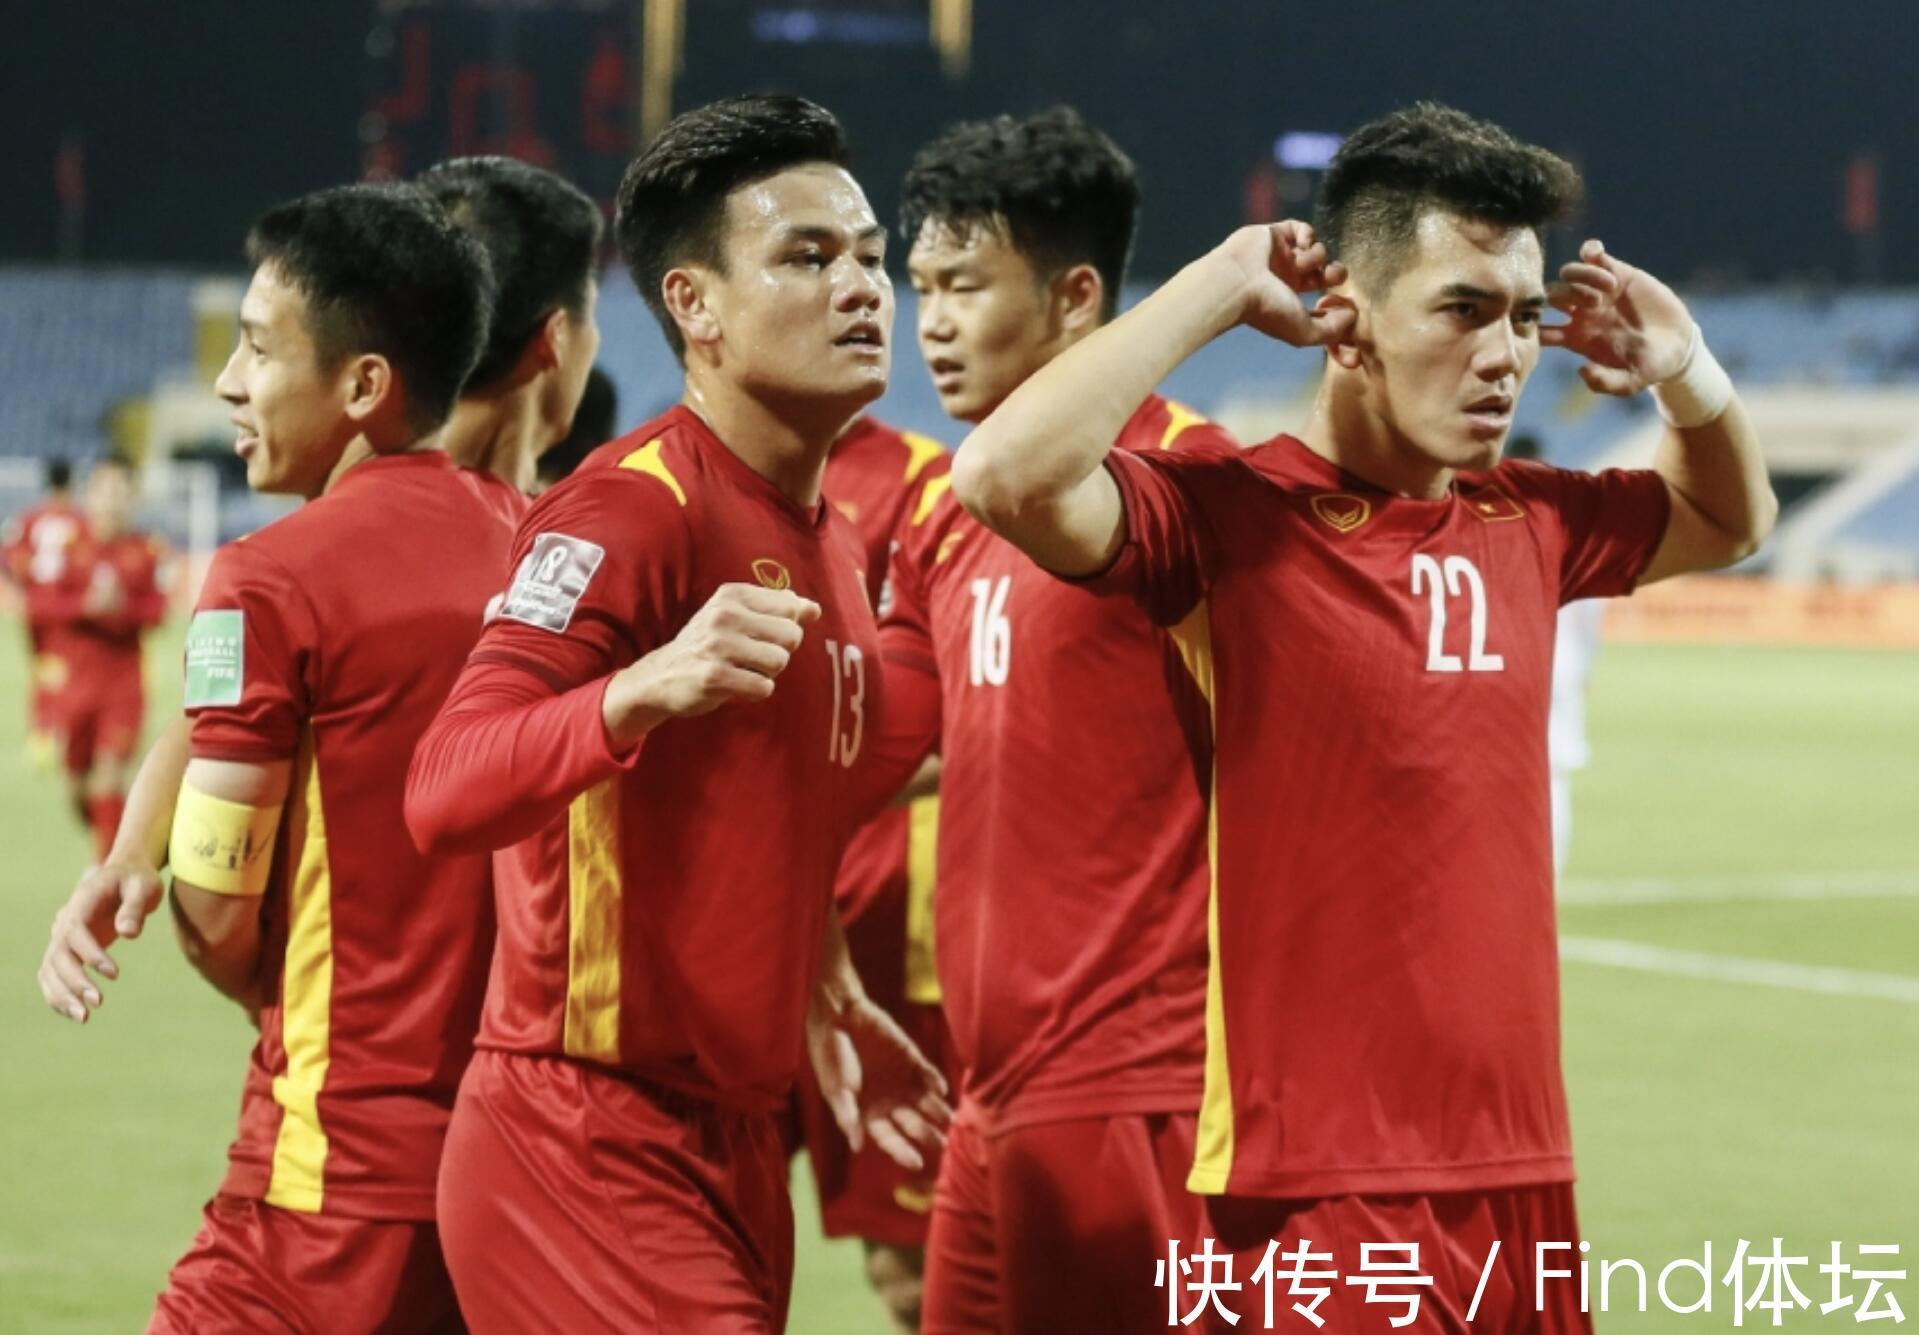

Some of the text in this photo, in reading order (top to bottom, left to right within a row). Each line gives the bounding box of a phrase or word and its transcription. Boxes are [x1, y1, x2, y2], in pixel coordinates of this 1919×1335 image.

[969, 577, 1012, 687] 16
[1411, 553, 1504, 673] 22
[825, 638, 865, 768] 13
